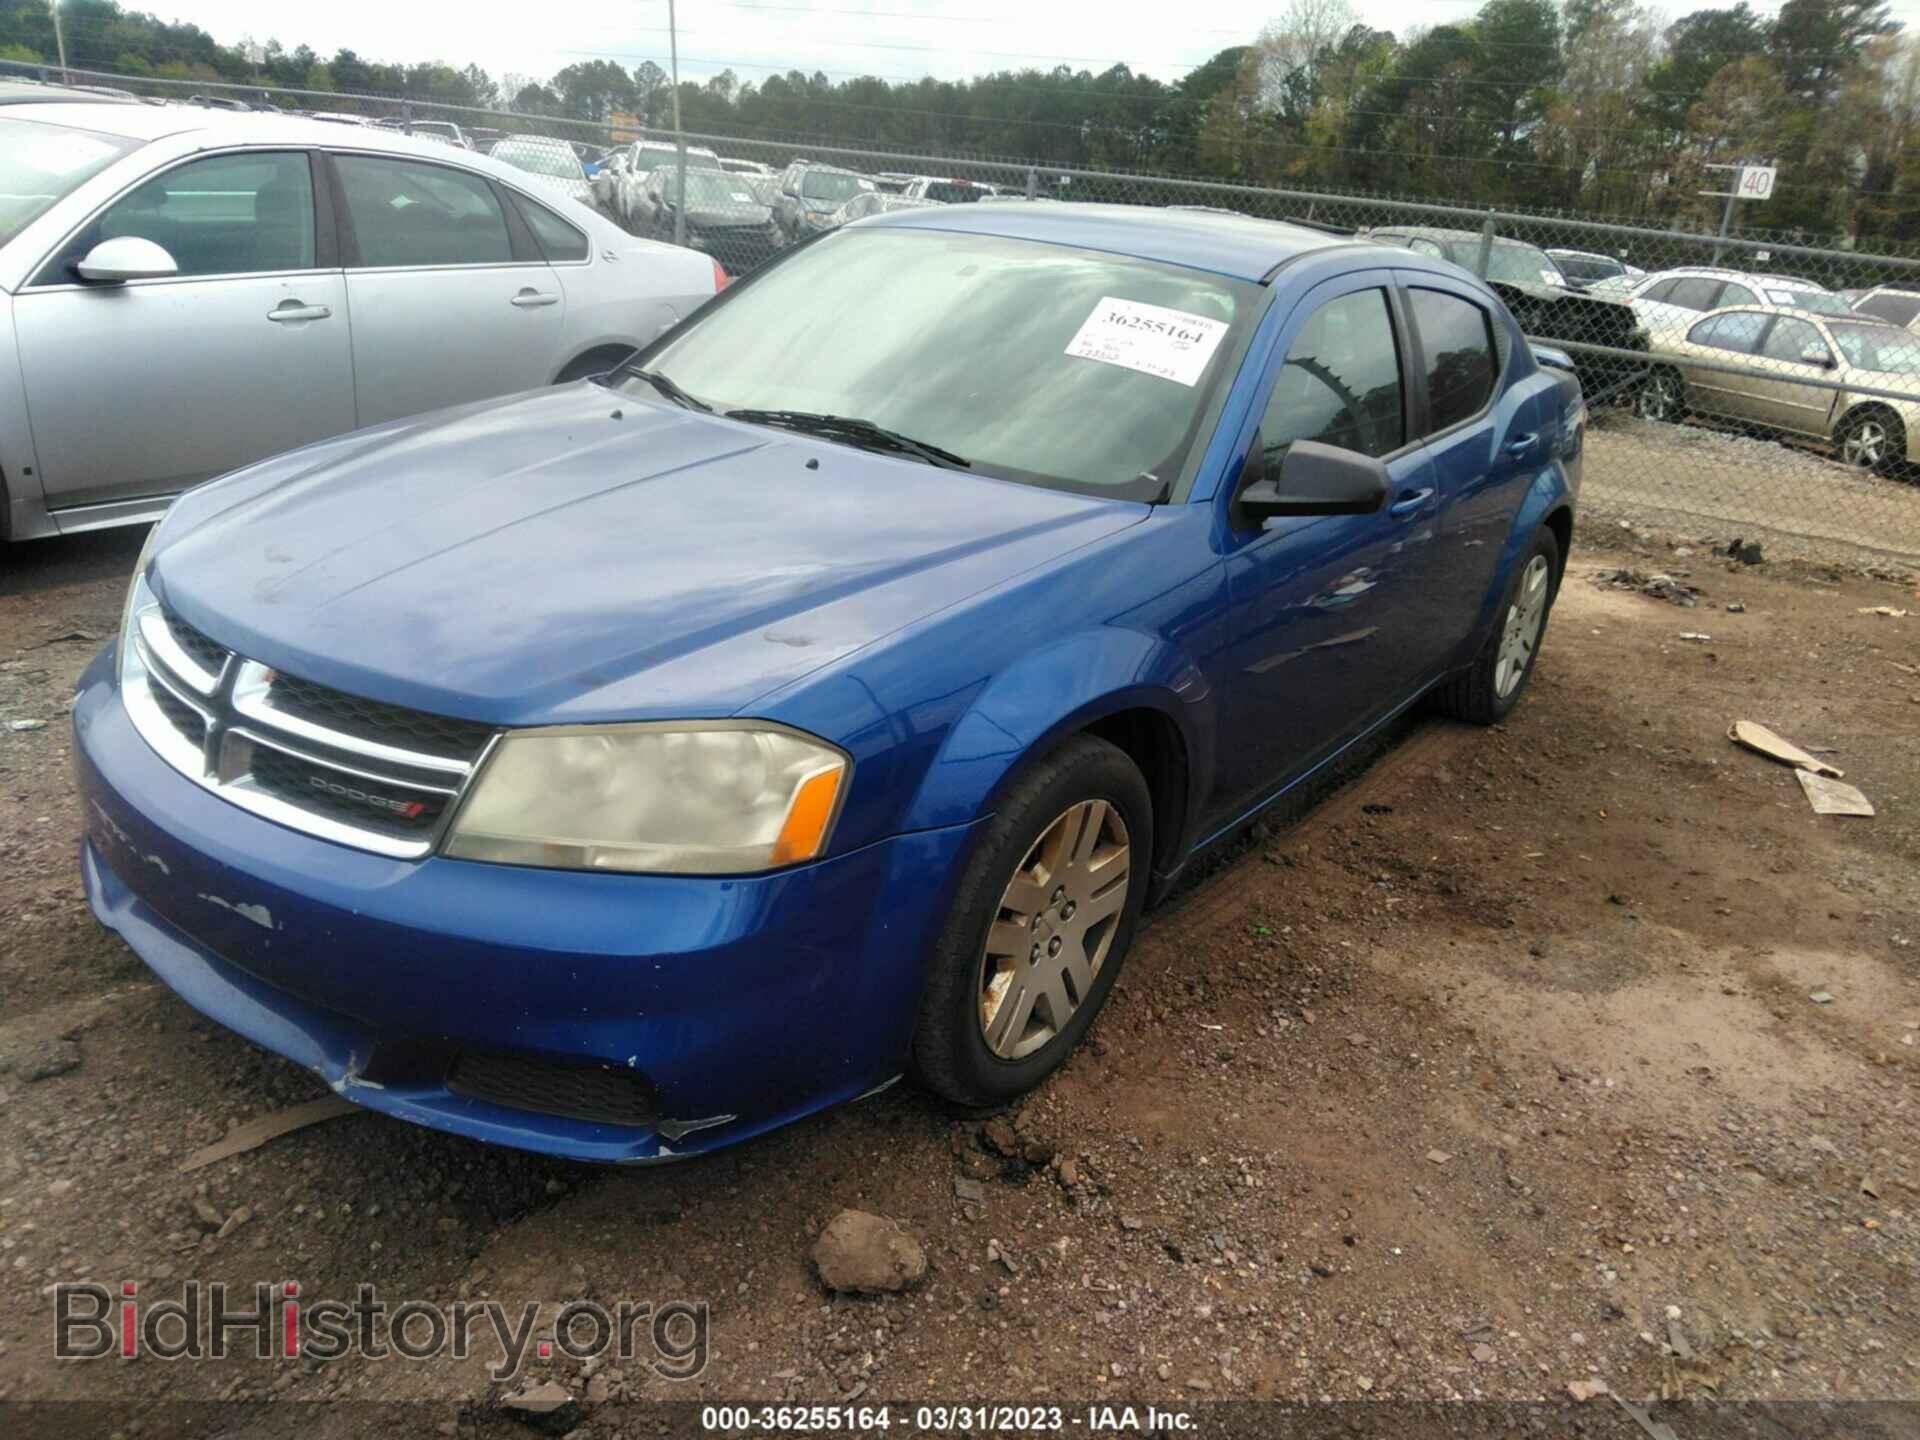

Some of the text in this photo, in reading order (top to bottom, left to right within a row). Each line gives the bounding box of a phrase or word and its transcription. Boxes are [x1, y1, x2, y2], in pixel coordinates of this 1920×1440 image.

[1744, 171, 1770, 195] 40
[1102, 311, 1205, 344] 36255164
[309, 775, 408, 813] DODGE
